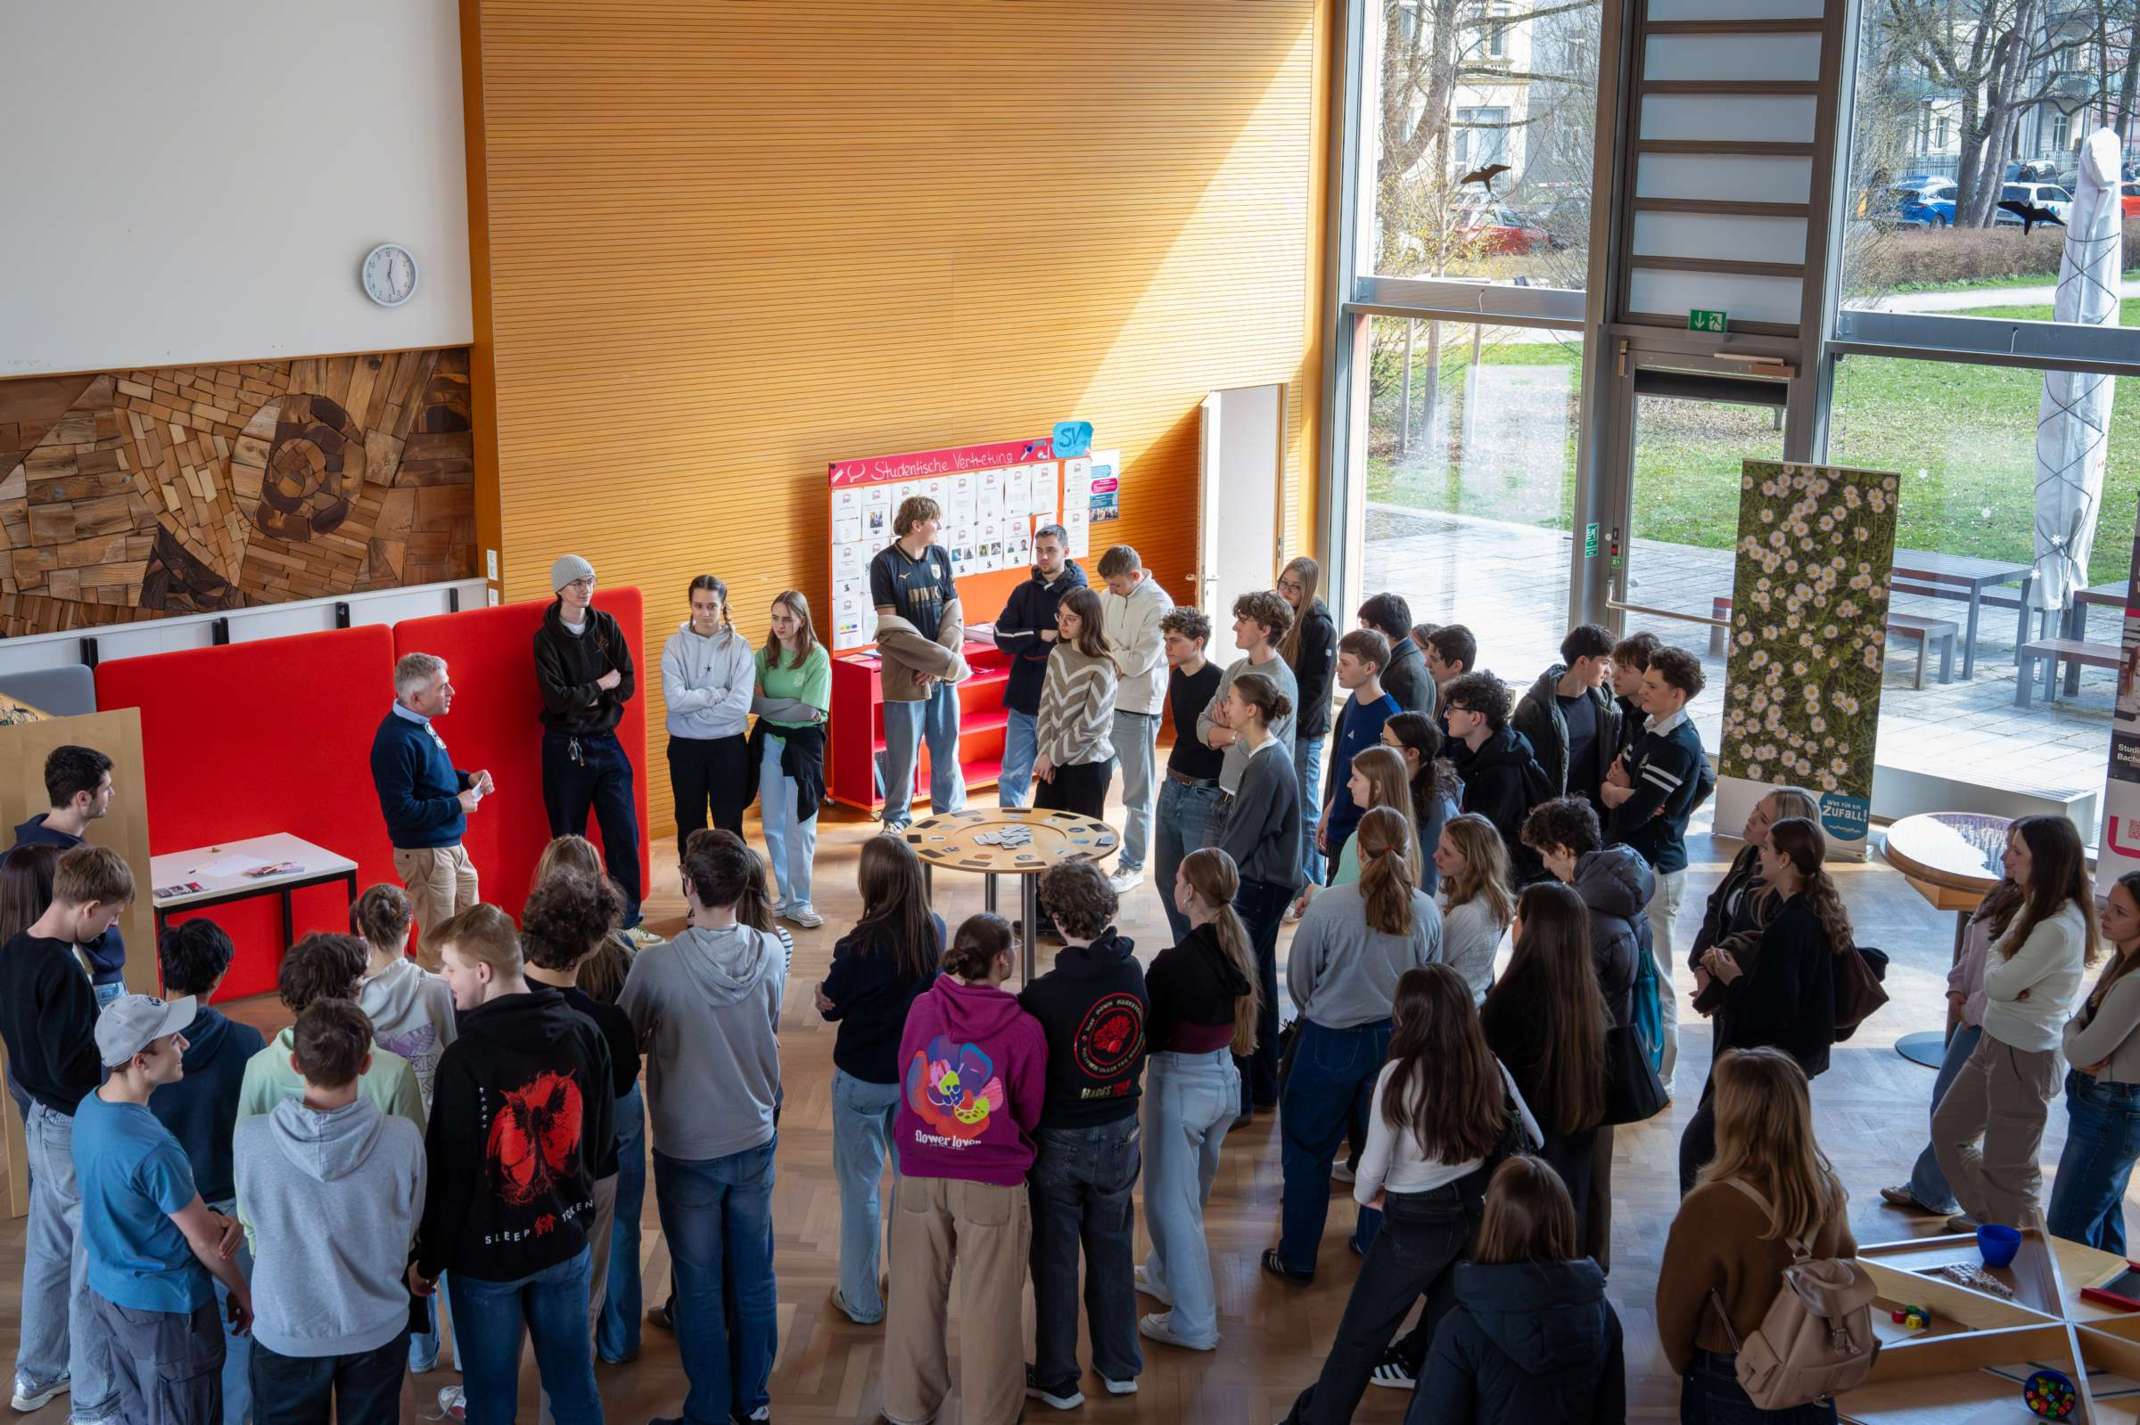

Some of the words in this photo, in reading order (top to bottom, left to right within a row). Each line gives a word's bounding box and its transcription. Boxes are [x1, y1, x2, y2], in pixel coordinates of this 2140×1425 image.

[1059, 427, 1082, 447] SV
[871, 457, 950, 480] Studentische
[952, 451, 1013, 470] Vertretung
[915, 1129, 951, 1146] flower
[485, 1229, 531, 1245] SLEEP
[562, 1199, 594, 1222] TOKEN
